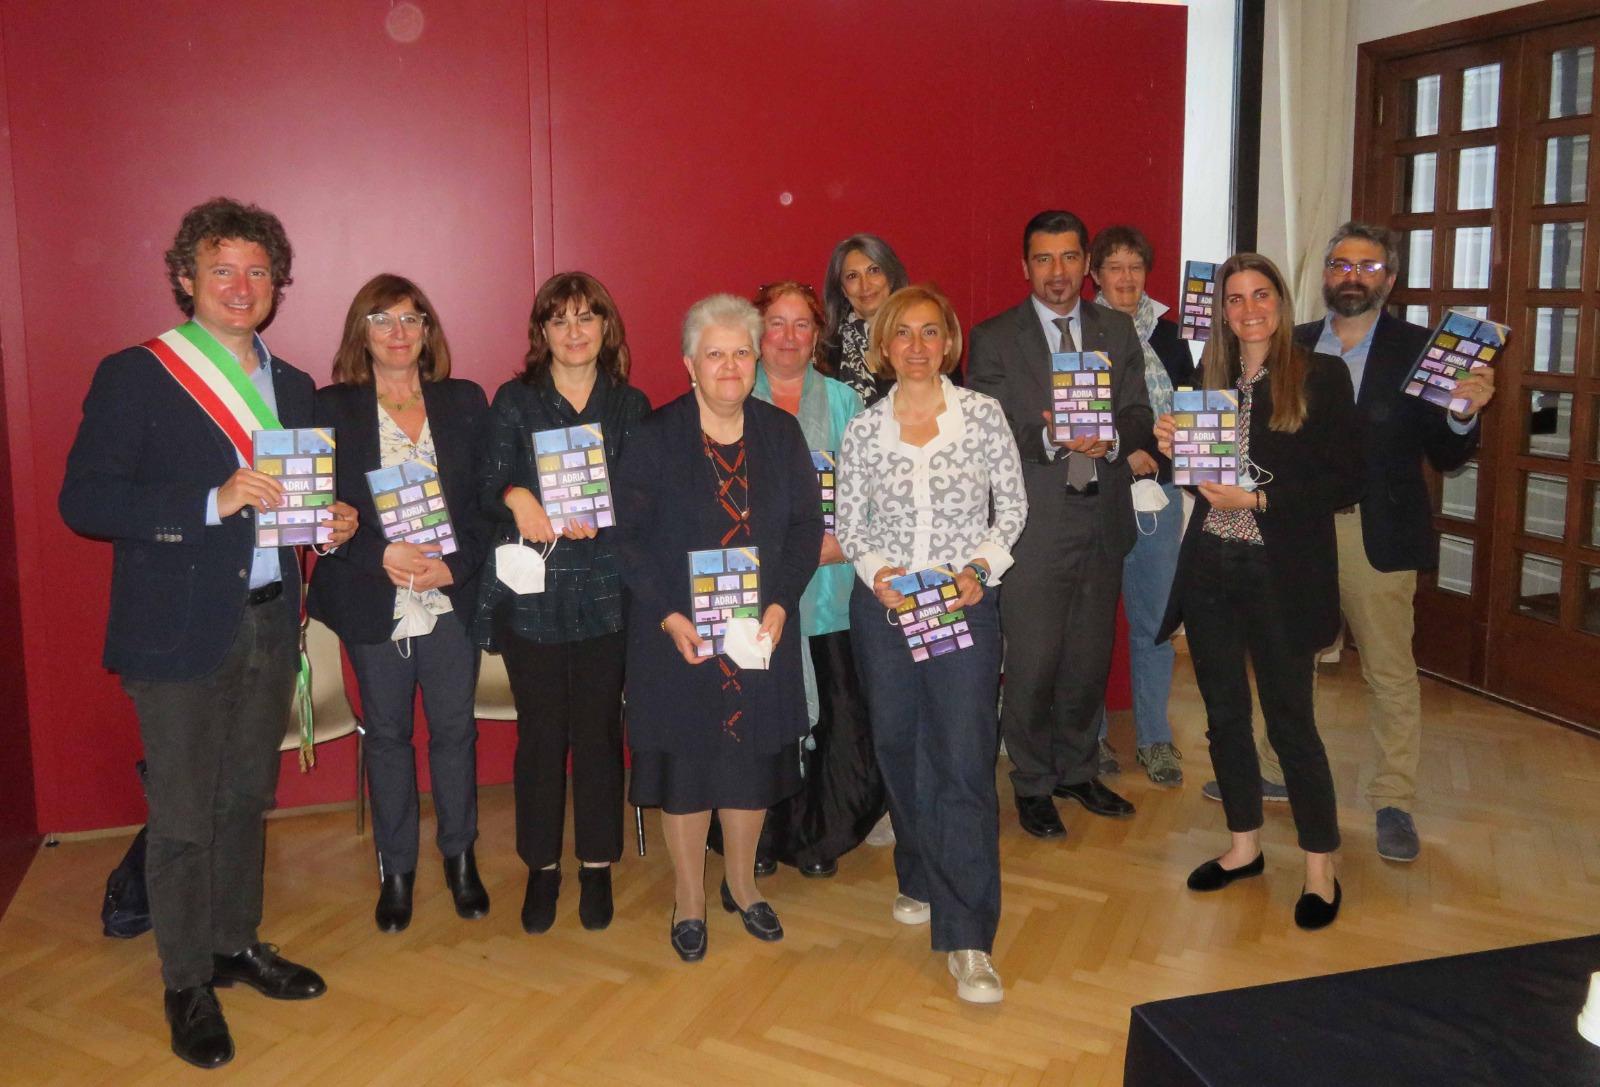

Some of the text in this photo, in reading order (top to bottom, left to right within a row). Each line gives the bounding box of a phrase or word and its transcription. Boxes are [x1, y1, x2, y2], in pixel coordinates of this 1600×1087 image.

[1201, 296, 1212, 304] ADR
[1445, 354, 1467, 367] ADRIA
[1072, 389, 1094, 398] ADRIA
[1193, 432, 1216, 441] ADRIA
[562, 472, 586, 483] ADRIA
[402, 504, 425, 519] ADRIA
[714, 595, 738, 605] ADRIA
[919, 606, 942, 618] ADRIA
